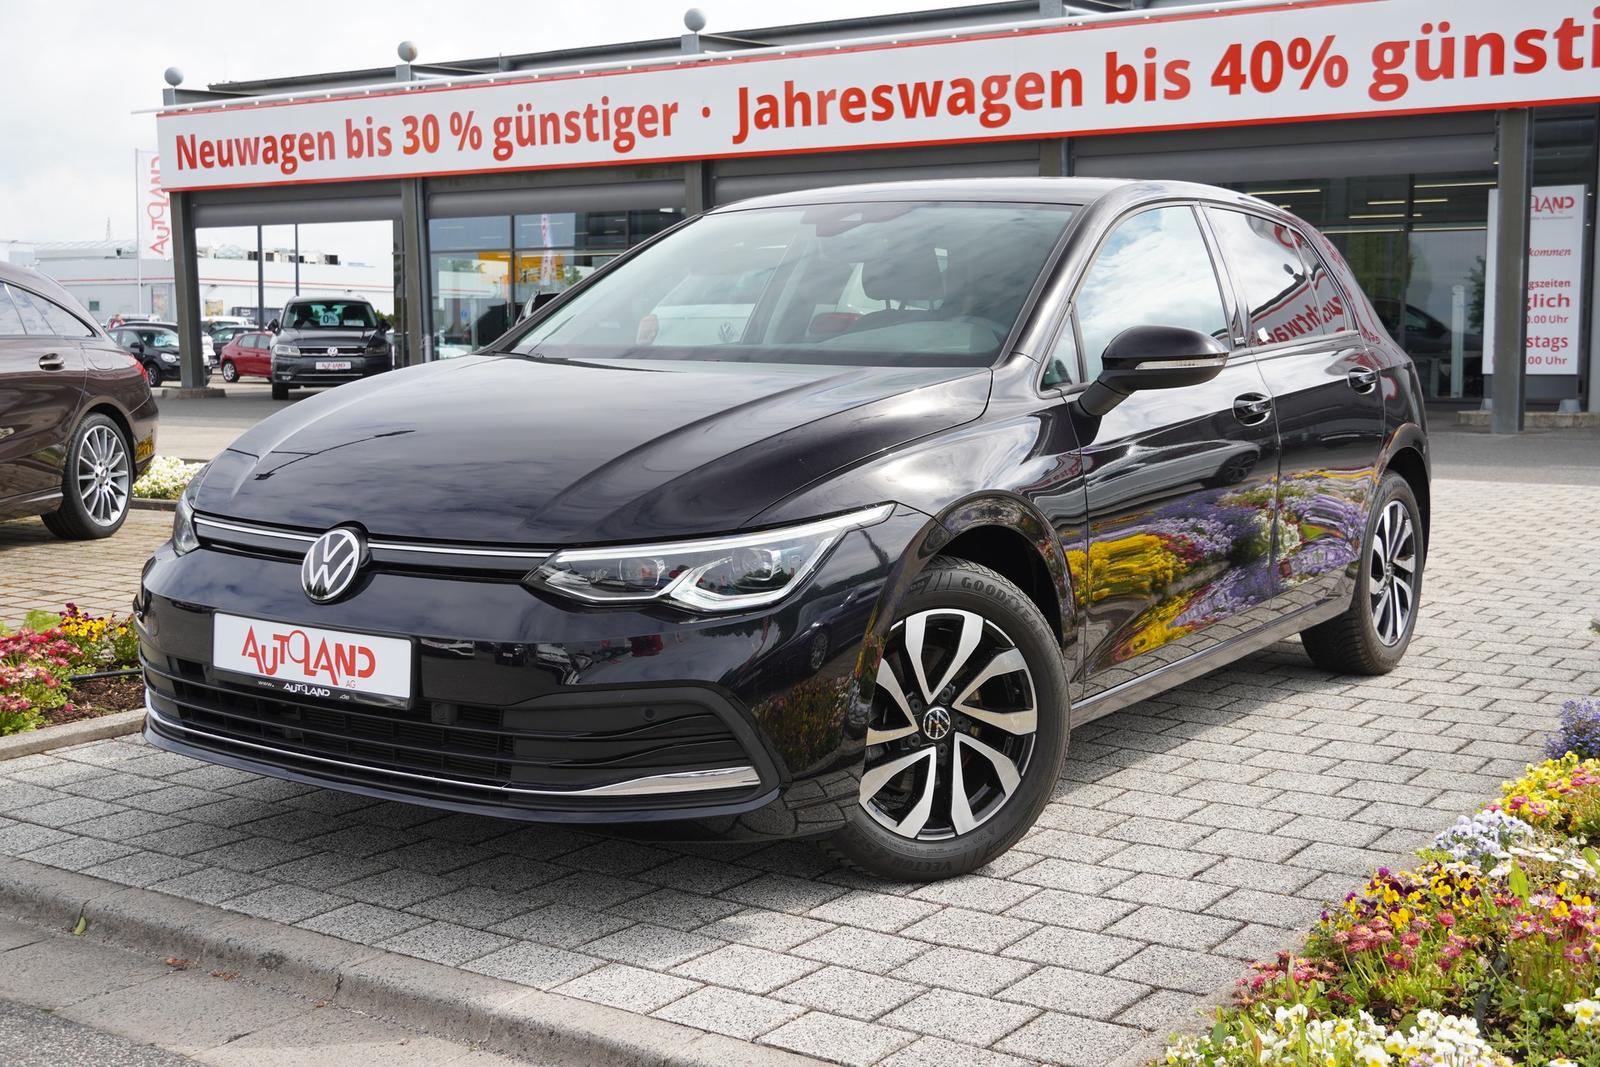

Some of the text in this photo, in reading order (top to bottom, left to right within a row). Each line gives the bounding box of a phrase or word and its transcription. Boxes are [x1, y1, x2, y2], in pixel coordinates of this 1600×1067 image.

[732, 69, 1082, 144] Jahreswagen
[1106, 48, 1190, 104] bis
[1211, 36, 1348, 95] 40%
[177, 96, 678, 174] Neuwagen bis 30 % günstiger
[1528, 247, 1571, 256] kommen
[1527, 279, 1571, 290] gszeiten
[1548, 315, 1569, 324] Uhr
[1526, 336, 1568, 352] stags
[1545, 356, 1567, 365] Uhr
[241, 624, 376, 686] AUTOLAND
[283, 683, 331, 697] AUTOLAND
